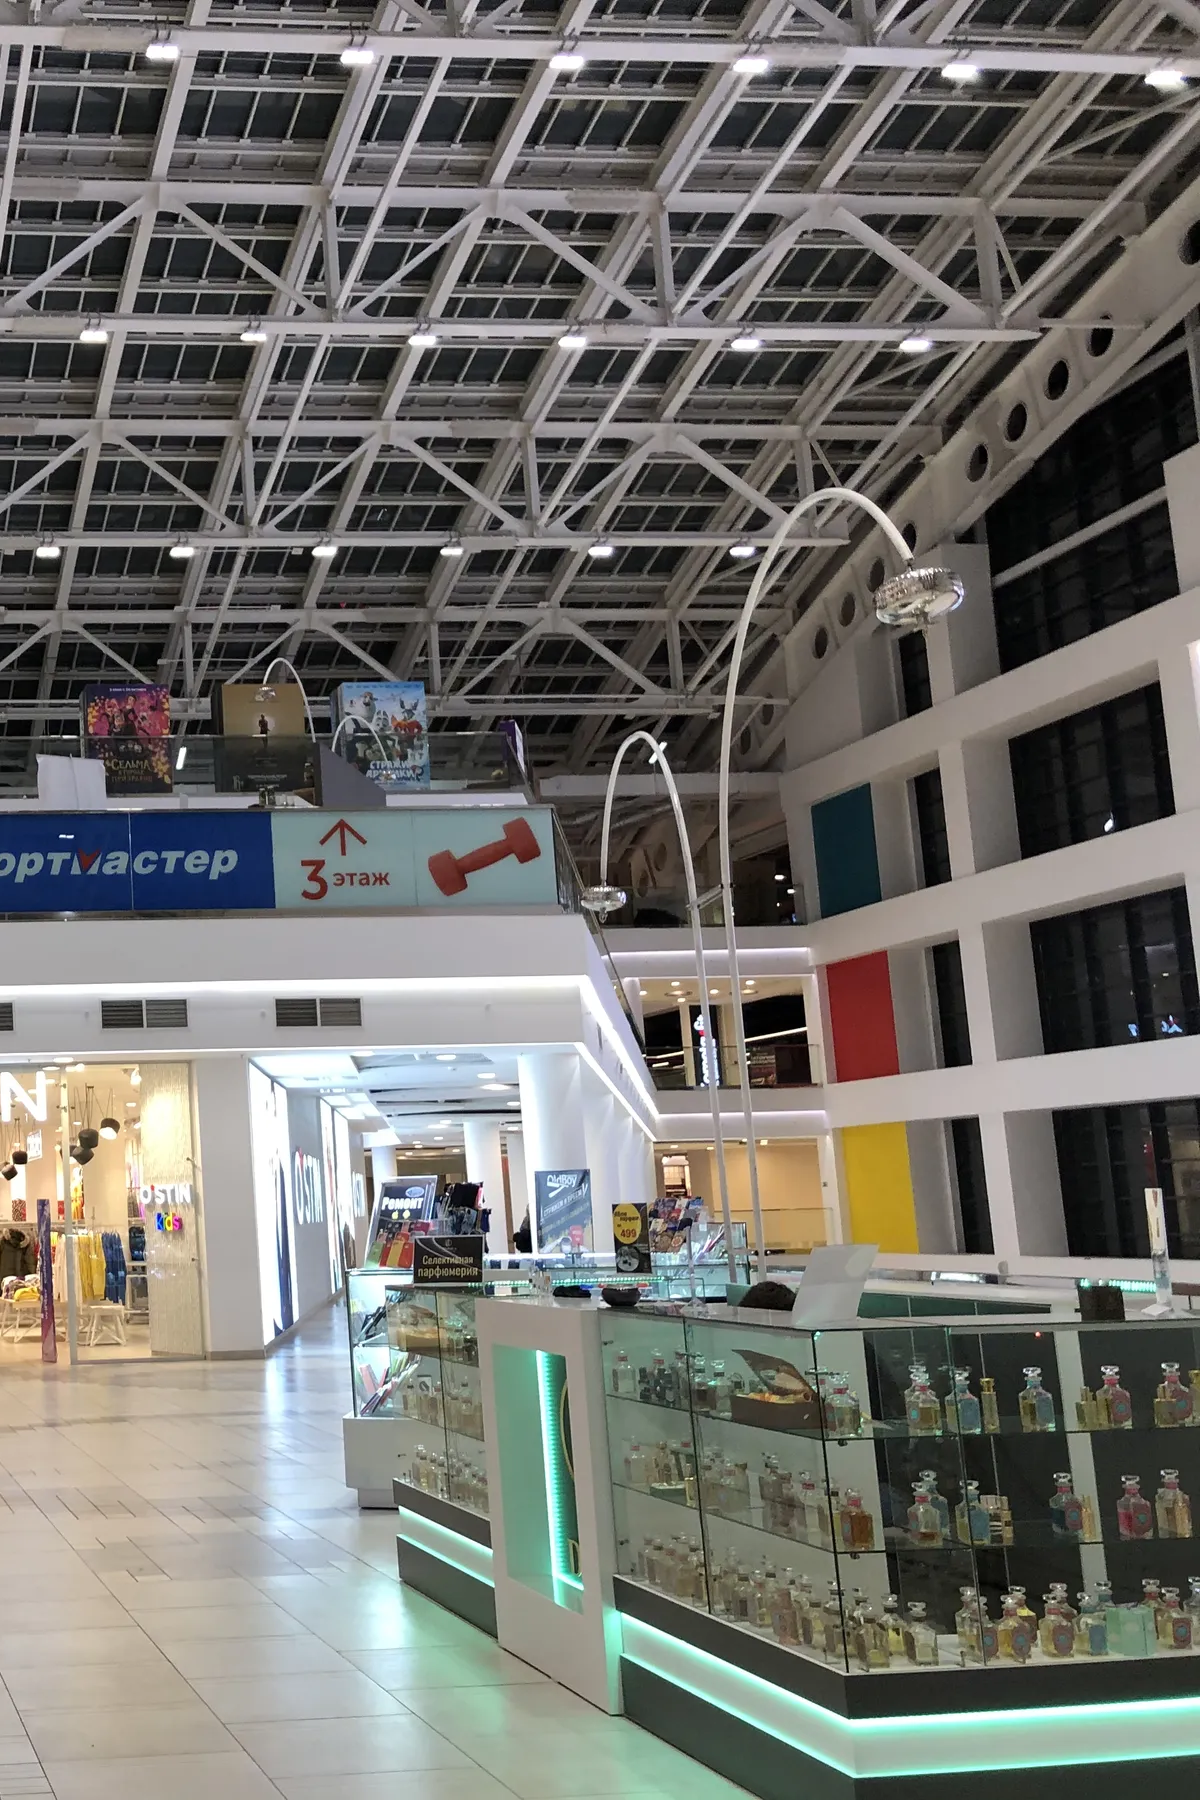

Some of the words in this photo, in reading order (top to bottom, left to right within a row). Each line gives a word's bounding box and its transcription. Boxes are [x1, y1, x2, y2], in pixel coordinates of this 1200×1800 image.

[301, 859, 329, 900] 3
[332, 872, 390, 887] этаж
[620, 1228, 637, 1239] 499
[422, 1255, 474, 1266] Селективная
[417, 1266, 479, 1279] парфюмерия
